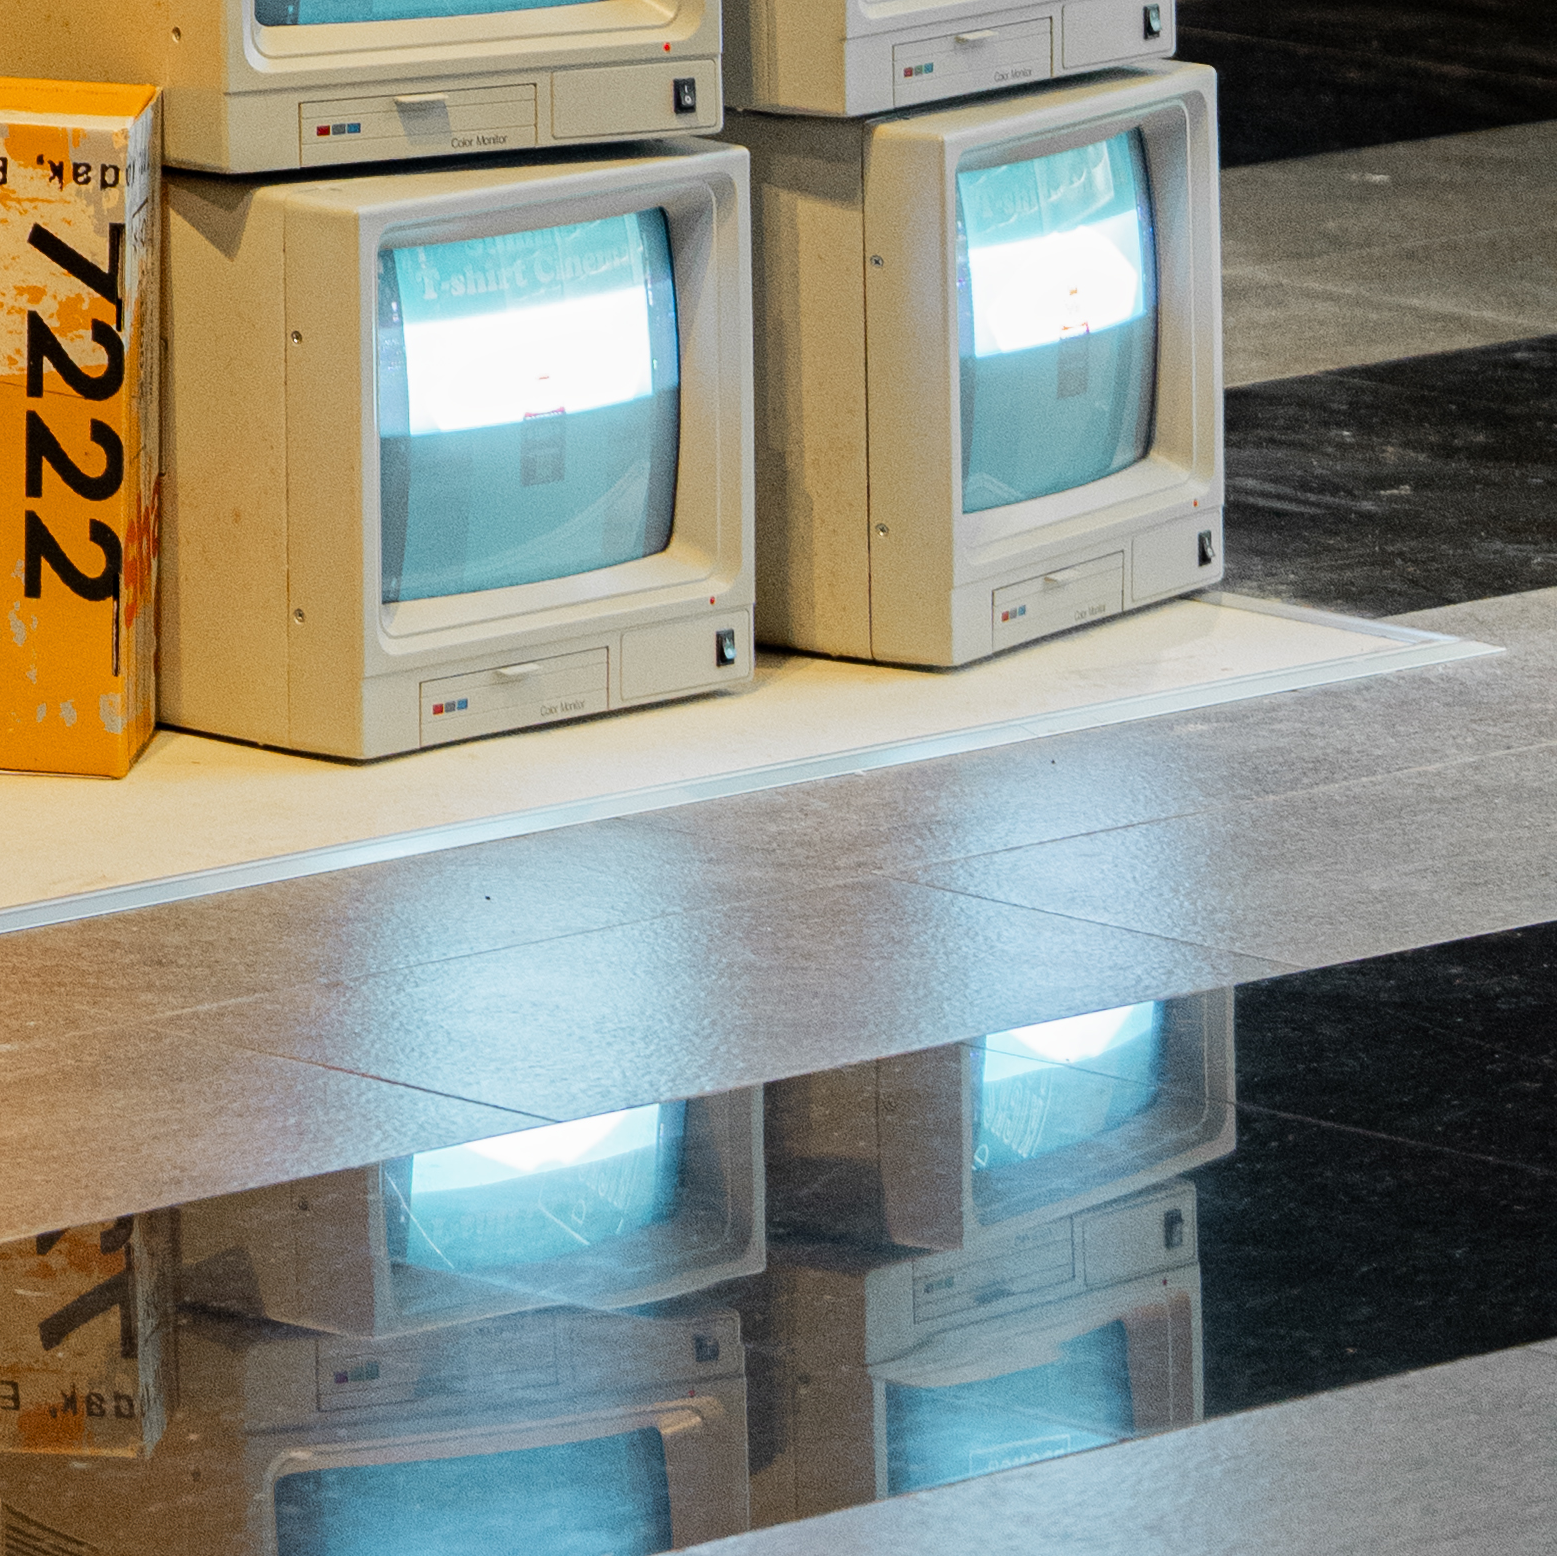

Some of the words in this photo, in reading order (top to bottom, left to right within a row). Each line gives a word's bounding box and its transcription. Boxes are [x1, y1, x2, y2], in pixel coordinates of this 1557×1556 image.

[450, 137, 473, 149] Color
[476, 134, 508, 146] Monitor
[23, 222, 126, 602] 7222
